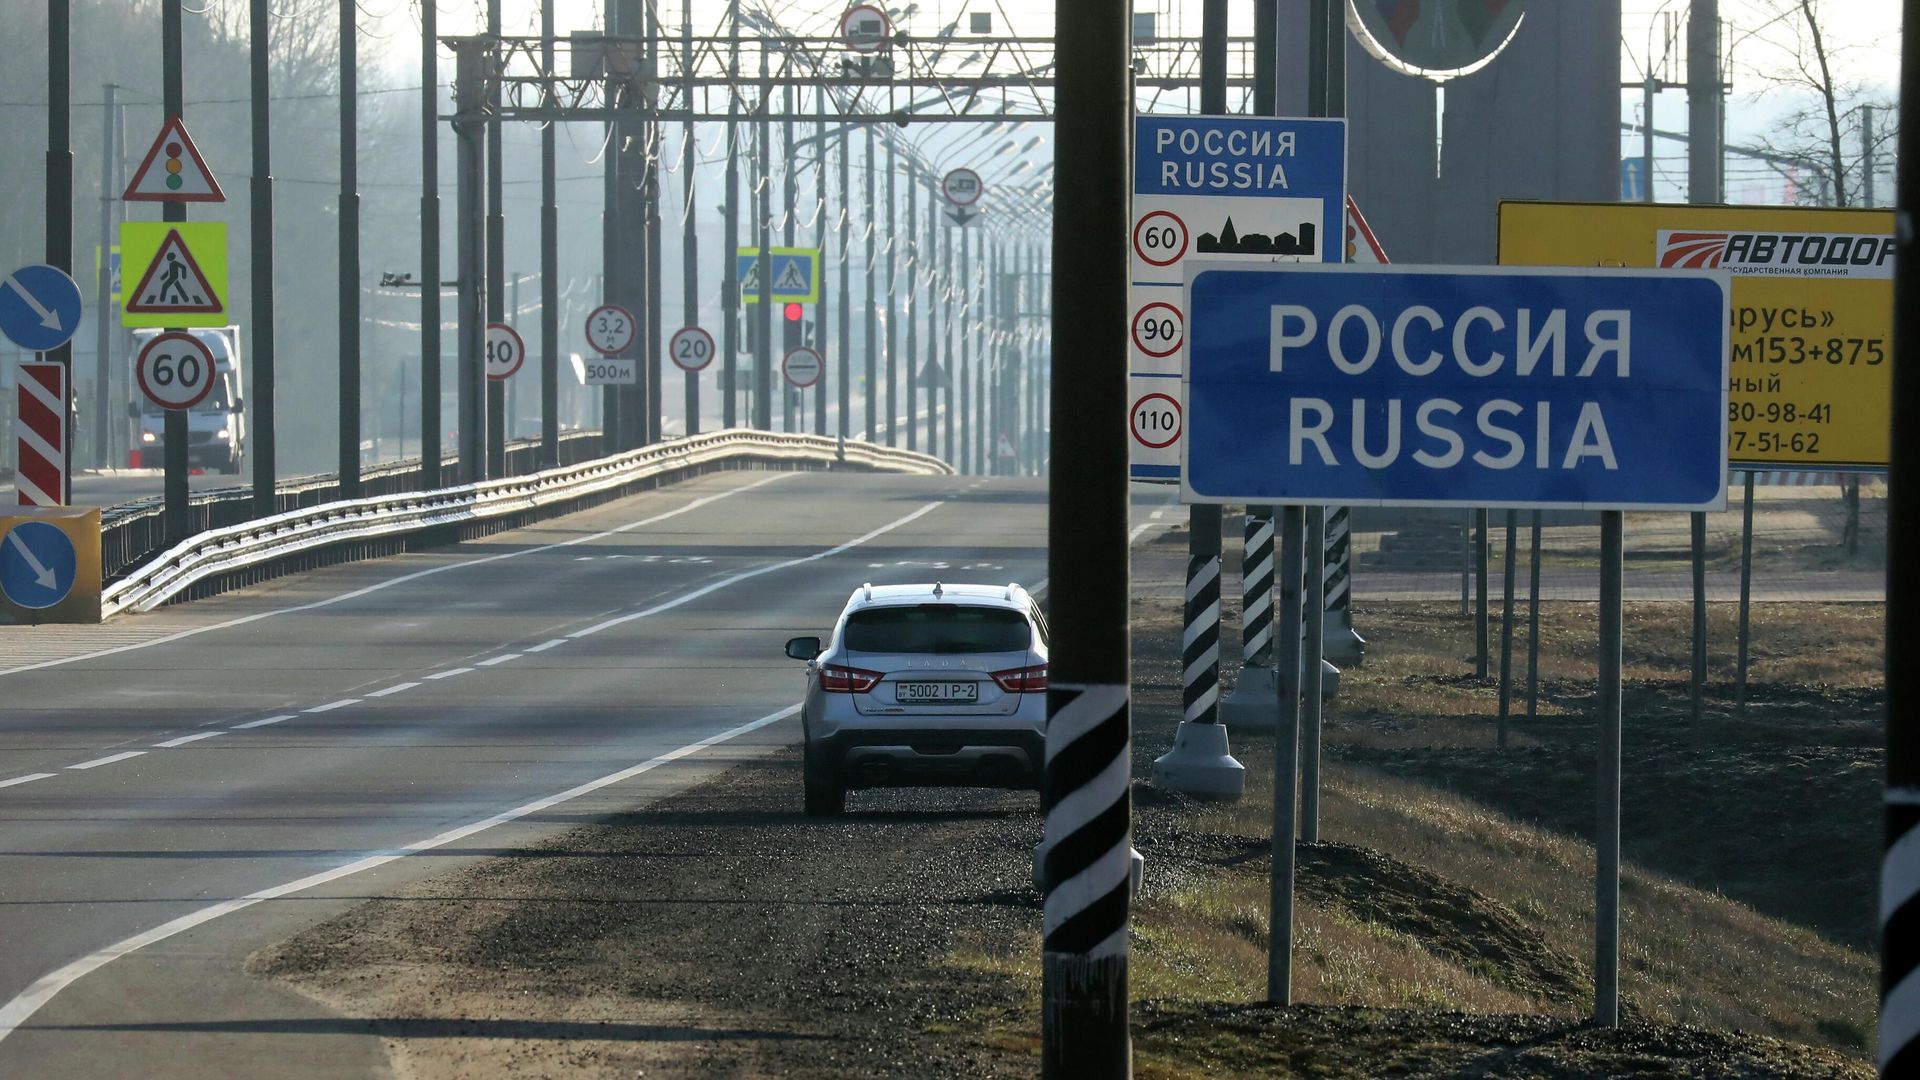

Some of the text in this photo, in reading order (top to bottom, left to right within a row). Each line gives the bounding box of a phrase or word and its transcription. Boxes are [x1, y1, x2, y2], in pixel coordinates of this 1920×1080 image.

[1156, 128, 1295, 157] РОССИЯ
[1161, 161, 1288, 189] RUSSIA
[1145, 227, 1176, 249] 60
[1722, 266, 1849, 275] СУДАРСТВЕННАЯ КОМПАНИЯ
[1144, 318, 1175, 341] 90
[1269, 304, 1631, 377] РОССИЯ
[679, 338, 706, 359] 20
[153, 354, 200, 388] 60
[1139, 411, 1174, 431] 110
[1729, 402, 1831, 424] 80-98-41
[1289, 397, 1618, 470] RUSSIA
[1728, 431, 1819, 454] 7-51-62
[909, 684, 938, 698] 5002
